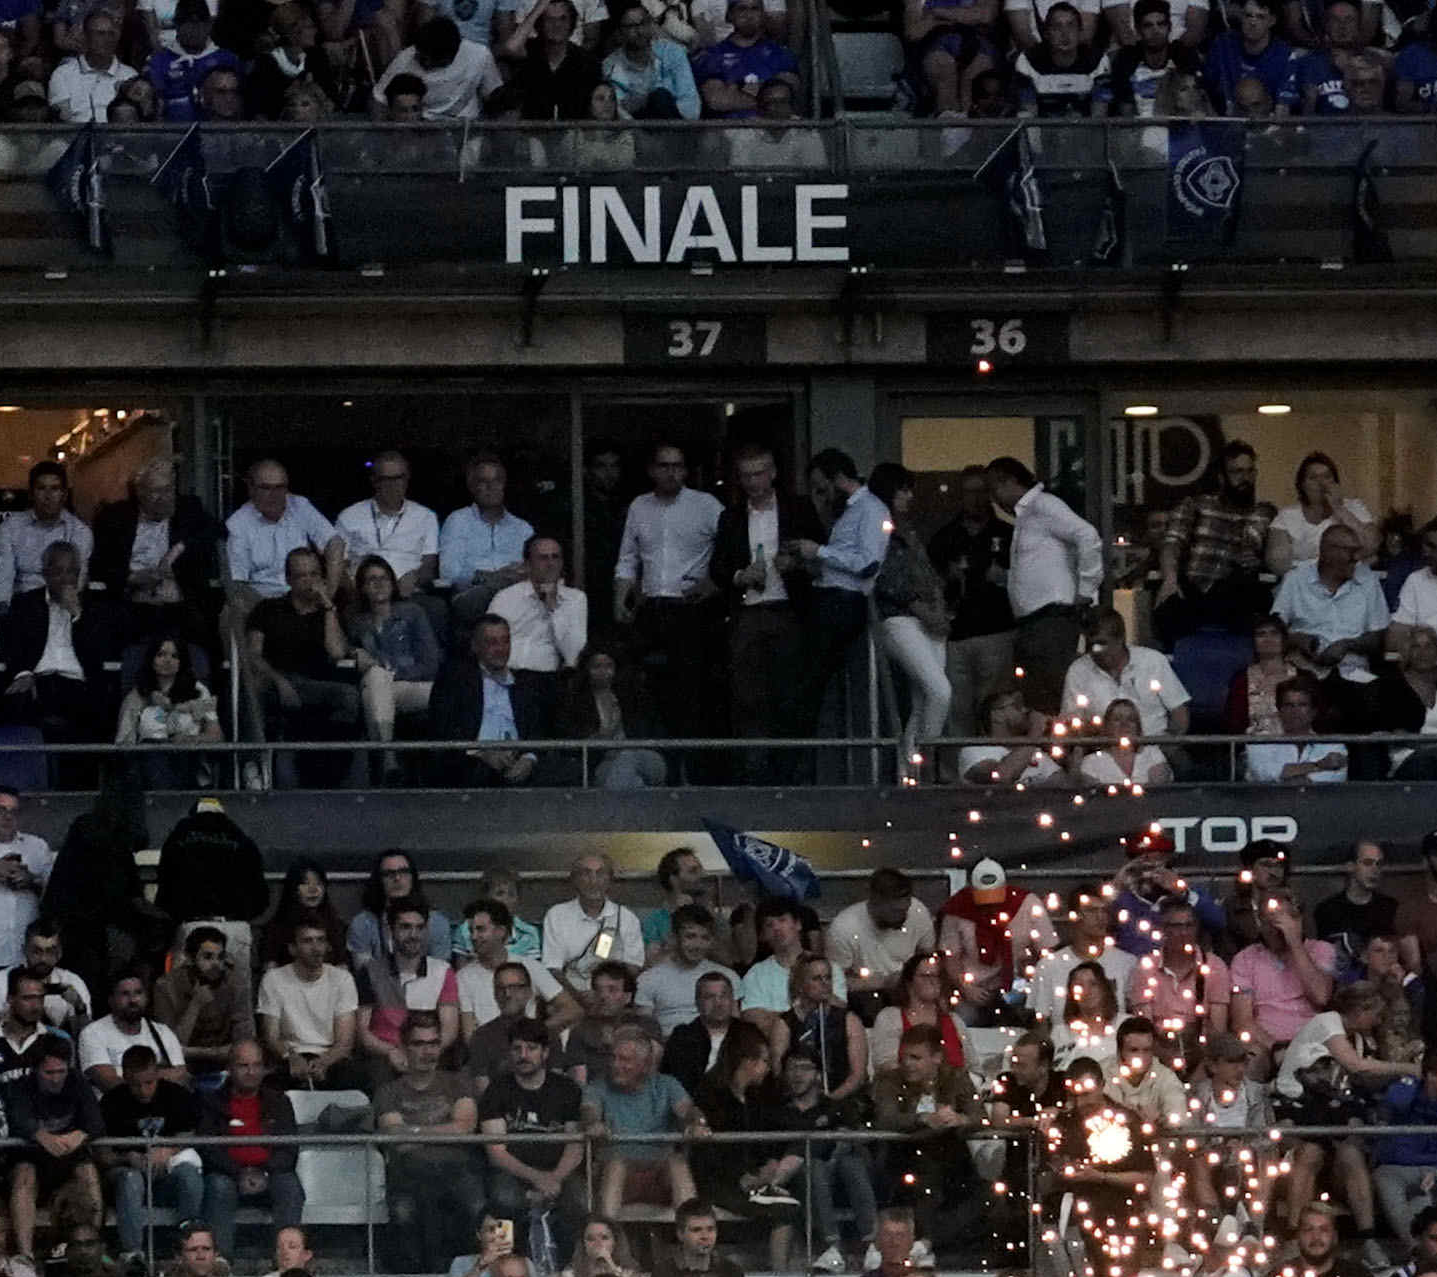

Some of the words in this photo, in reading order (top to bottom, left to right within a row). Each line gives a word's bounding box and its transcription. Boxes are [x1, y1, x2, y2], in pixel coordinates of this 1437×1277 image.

[504, 184, 849, 264] FINALE
[668, 320, 723, 359] 37
[970, 318, 1027, 357] 36
[1161, 816, 1299, 853] TOP
